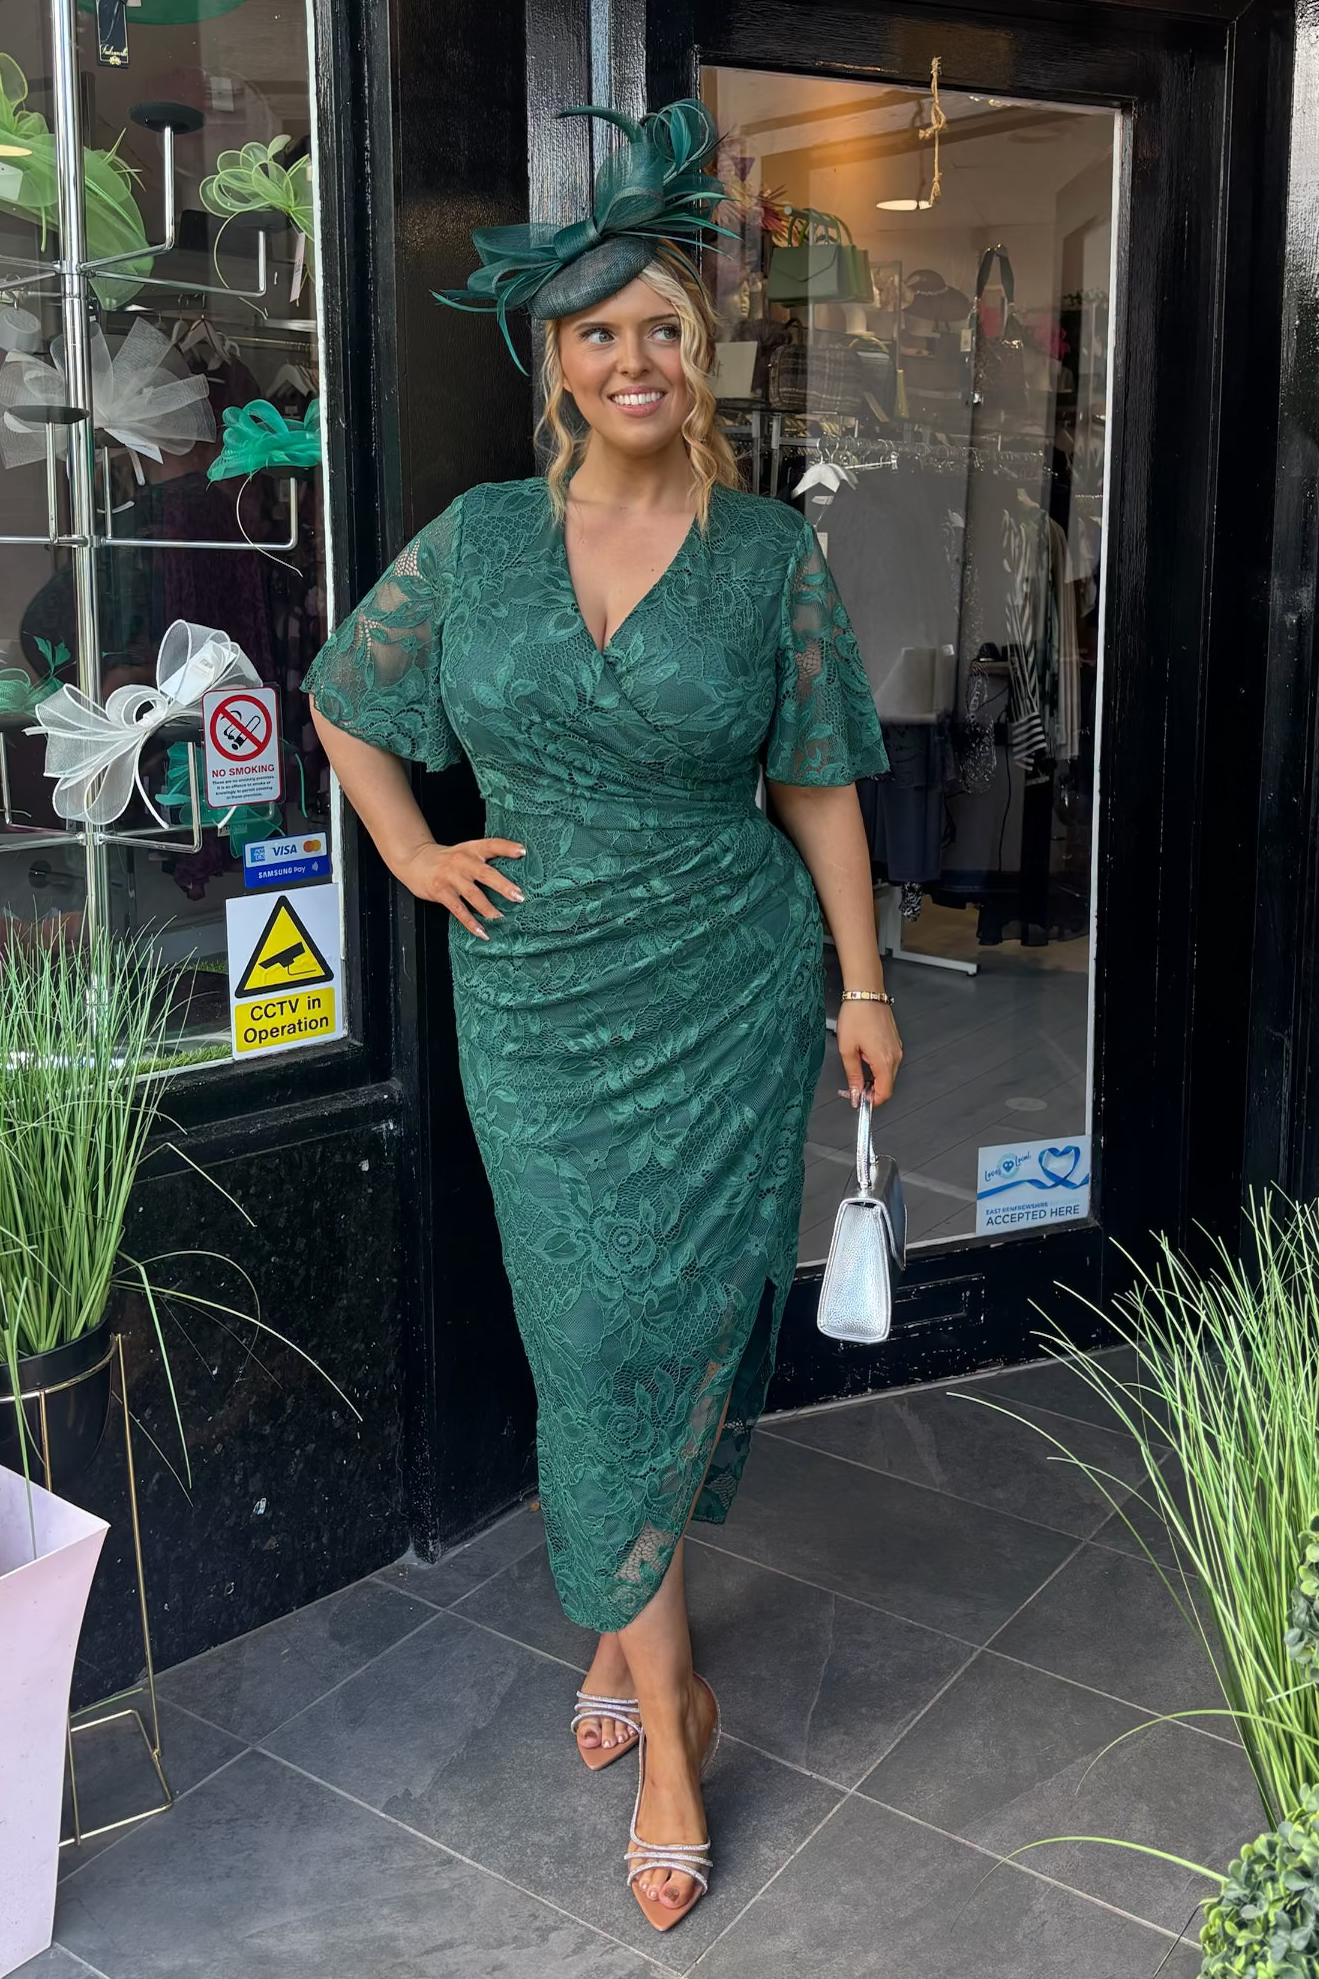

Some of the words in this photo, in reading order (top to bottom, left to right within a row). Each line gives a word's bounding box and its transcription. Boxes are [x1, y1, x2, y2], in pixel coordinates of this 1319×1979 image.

[212, 769, 226, 778] NO
[229, 764, 274, 776] SMOKING
[272, 844, 298, 856] VISA
[258, 868, 293, 879] SAMSUNG
[250, 998, 300, 1021] CCTV
[307, 996, 321, 1010] in
[244, 1016, 329, 1044] Operation
[1002, 1202, 1048, 1213] RENFREWSHIRE
[986, 1208, 1047, 1226] ACCEPTED
[1050, 1204, 1080, 1218] HERE
